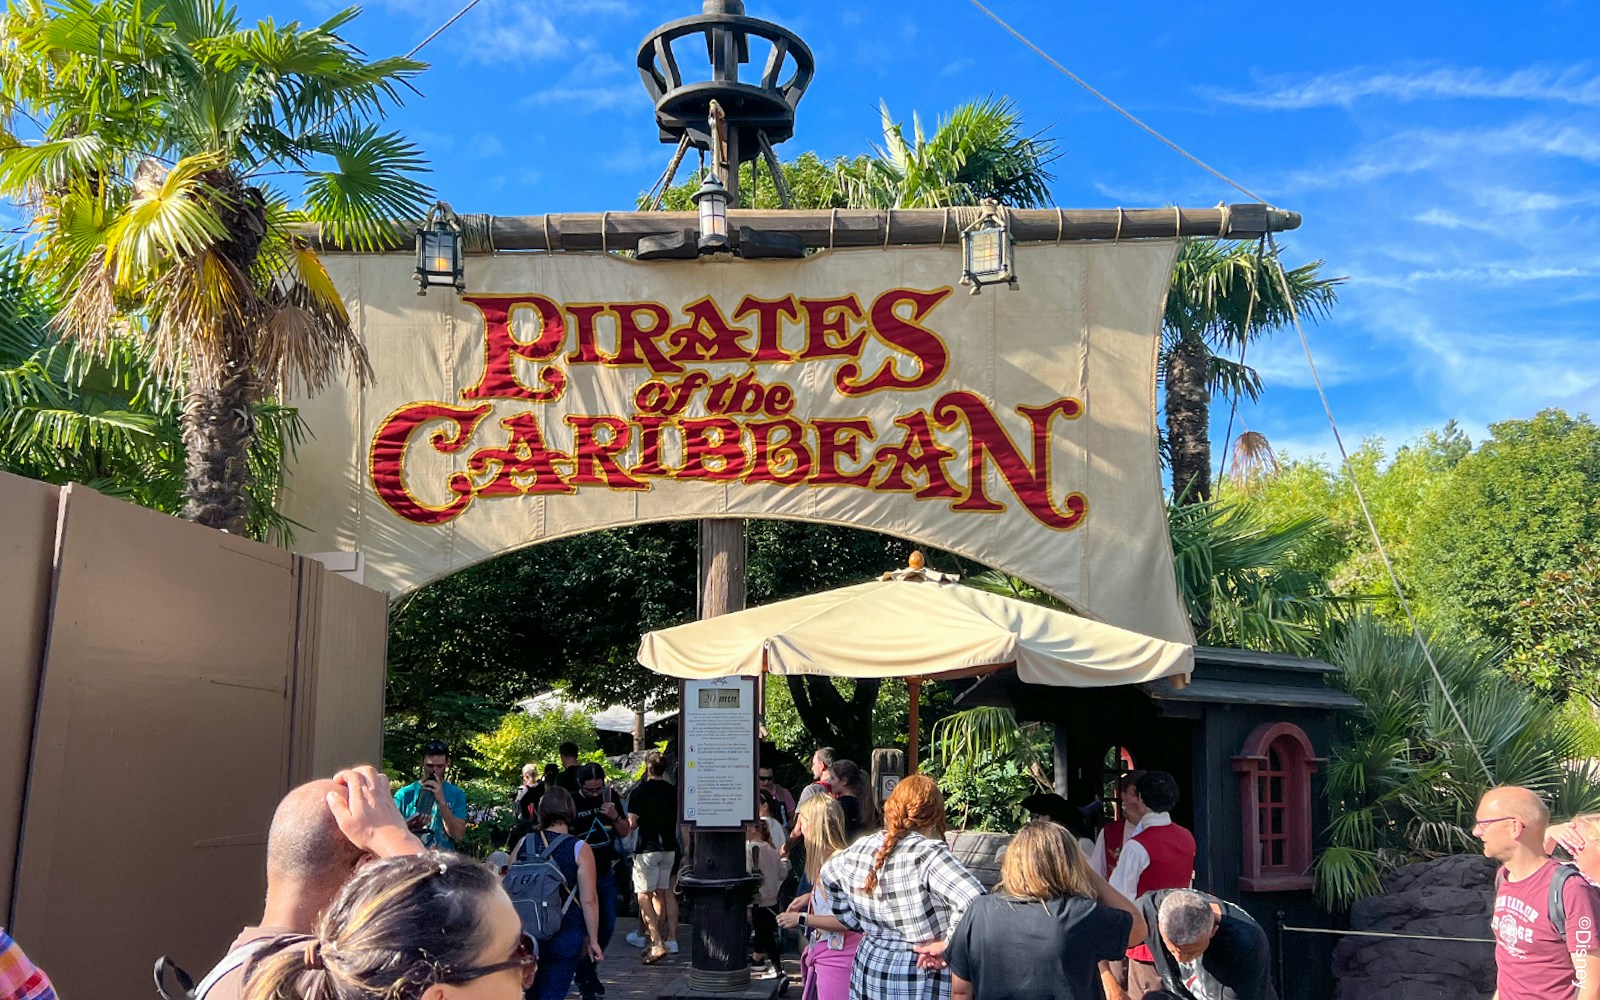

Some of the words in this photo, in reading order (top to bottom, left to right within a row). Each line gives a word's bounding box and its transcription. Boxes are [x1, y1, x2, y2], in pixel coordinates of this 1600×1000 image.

[460, 287, 953, 401] PIRATES
[634, 369, 710, 416] of
[704, 368, 797, 417] the
[371, 390, 1088, 531] CARIBBEAN
[703, 693, 717, 704] 20
[718, 693, 737, 704] min
[1507, 895, 1539, 923] TAILOR
[1517, 925, 1534, 944] 62
